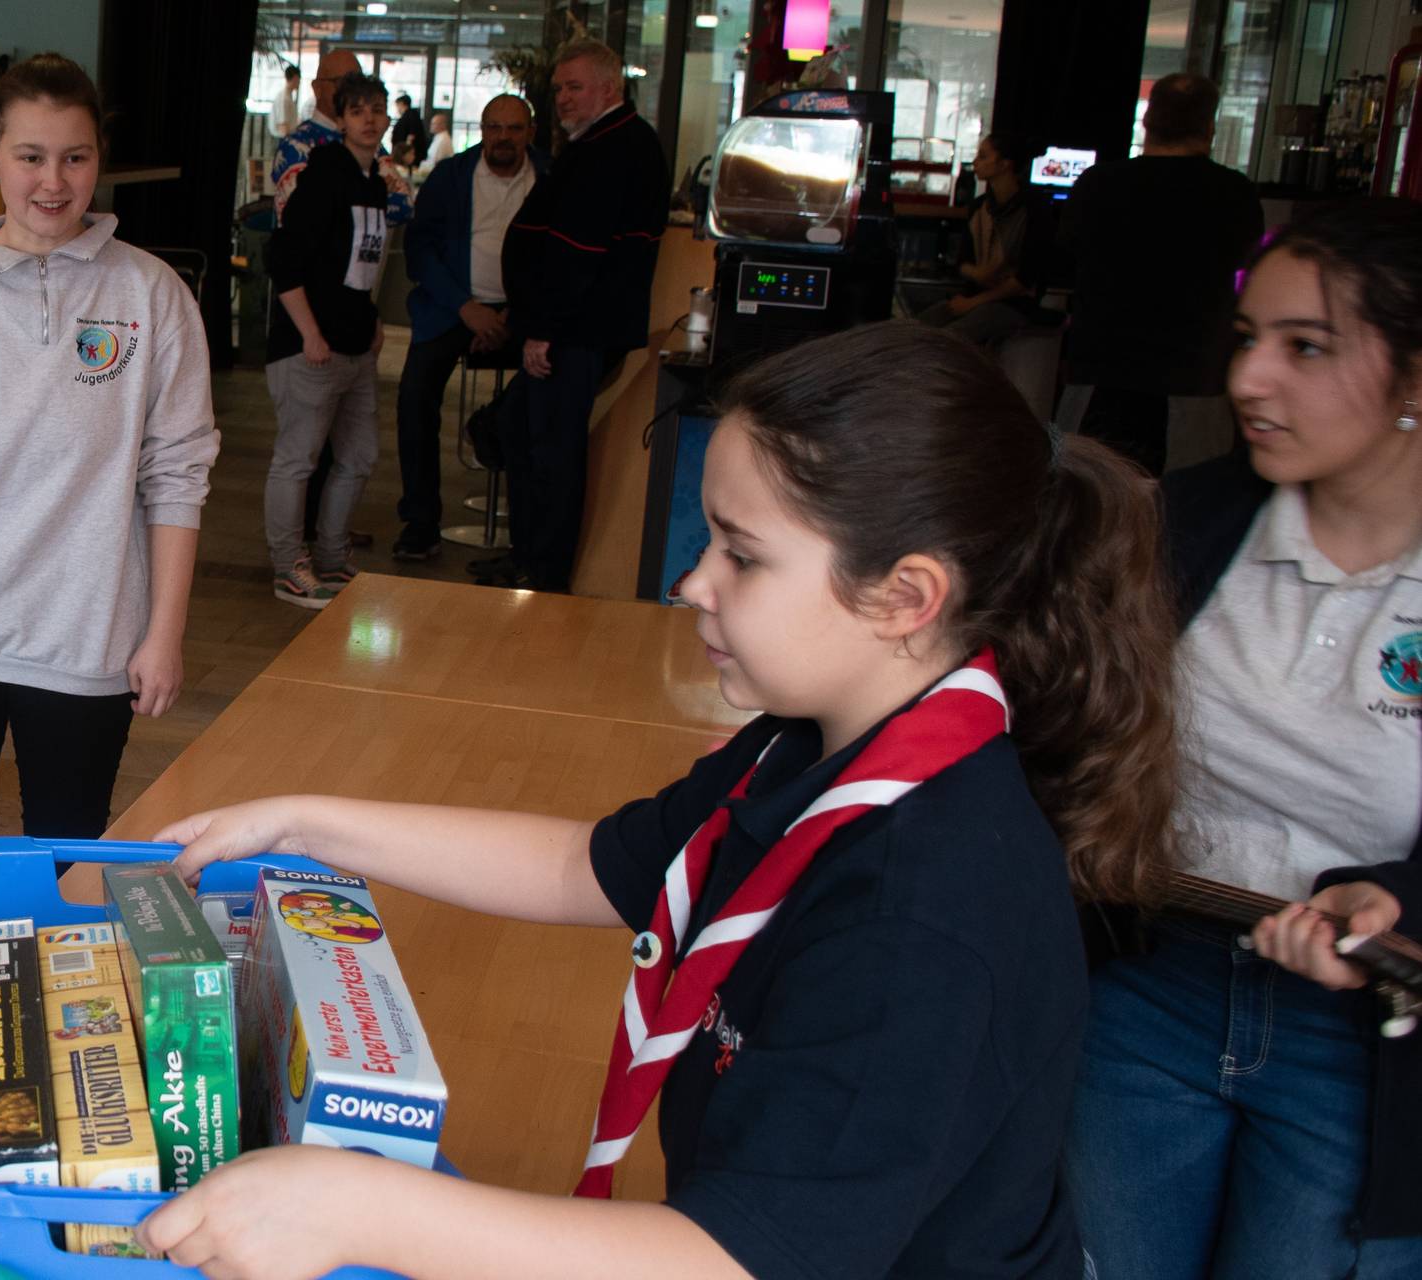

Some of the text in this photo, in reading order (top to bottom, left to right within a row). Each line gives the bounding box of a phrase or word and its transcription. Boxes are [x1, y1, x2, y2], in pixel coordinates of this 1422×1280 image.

[74, 336, 139, 386] Jugendrotkreuz
[274, 870, 361, 886] KOSMOS
[317, 1001, 352, 1060] Mein erster
[332, 946, 401, 1074] Experimentierkasten
[371, 973, 414, 1055] Naturgesetze ganz einfach
[160, 1049, 190, 1135] Akte
[195, 1074, 210, 1171] um 50 rätselhafte
[324, 1093, 436, 1129] KOSMOS
[80, 1131, 97, 1155] DIE
[210, 1093, 225, 1159] Alten China
